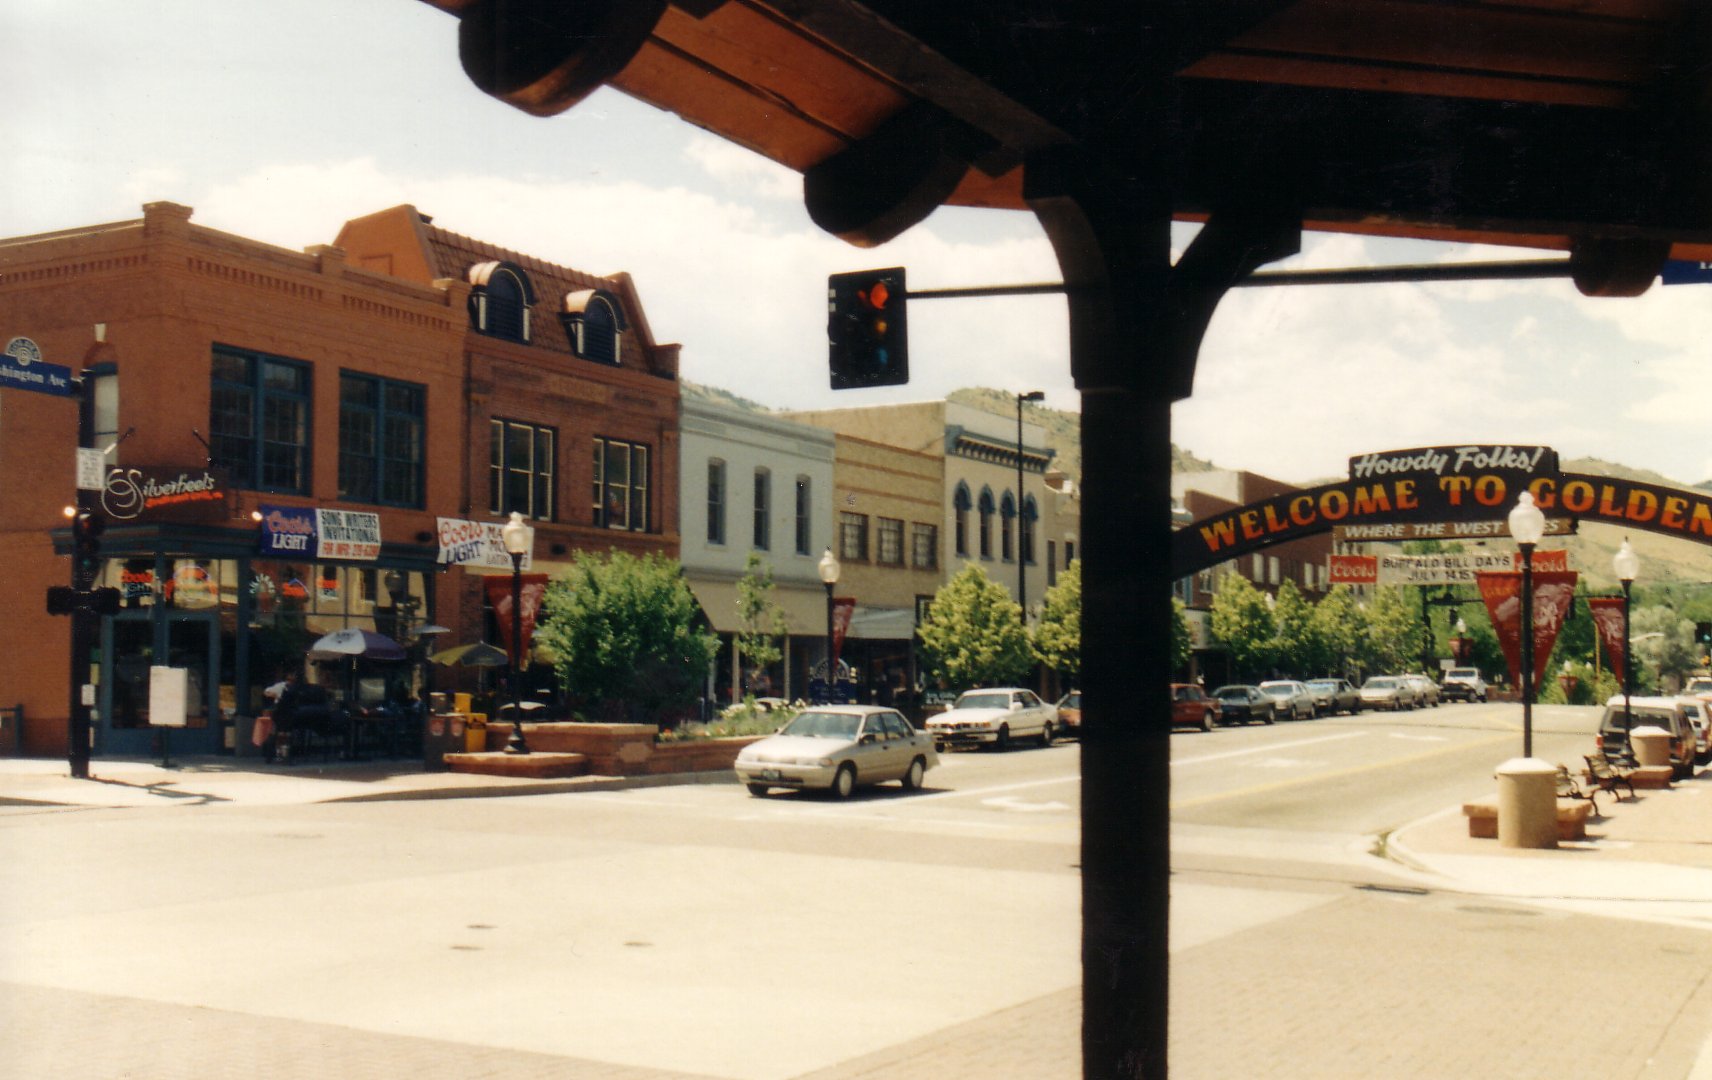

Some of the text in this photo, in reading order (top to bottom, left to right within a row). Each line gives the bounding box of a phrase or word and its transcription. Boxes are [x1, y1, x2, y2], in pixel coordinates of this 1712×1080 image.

[1354, 446, 1544, 478] Howdy Folks!
[1200, 475, 1712, 552] WELCOME TO GOLDEN
[440, 521, 484, 549] Coors
[1344, 522, 1504, 538] WHERE THE WEST
[272, 533, 309, 550] LIGHT
[446, 541, 482, 563] LIGHT
[1331, 561, 1376, 578] Coors
[1383, 556, 1510, 569] BUFFALO BILL DAYS
[1408, 569, 1438, 582] JULY
